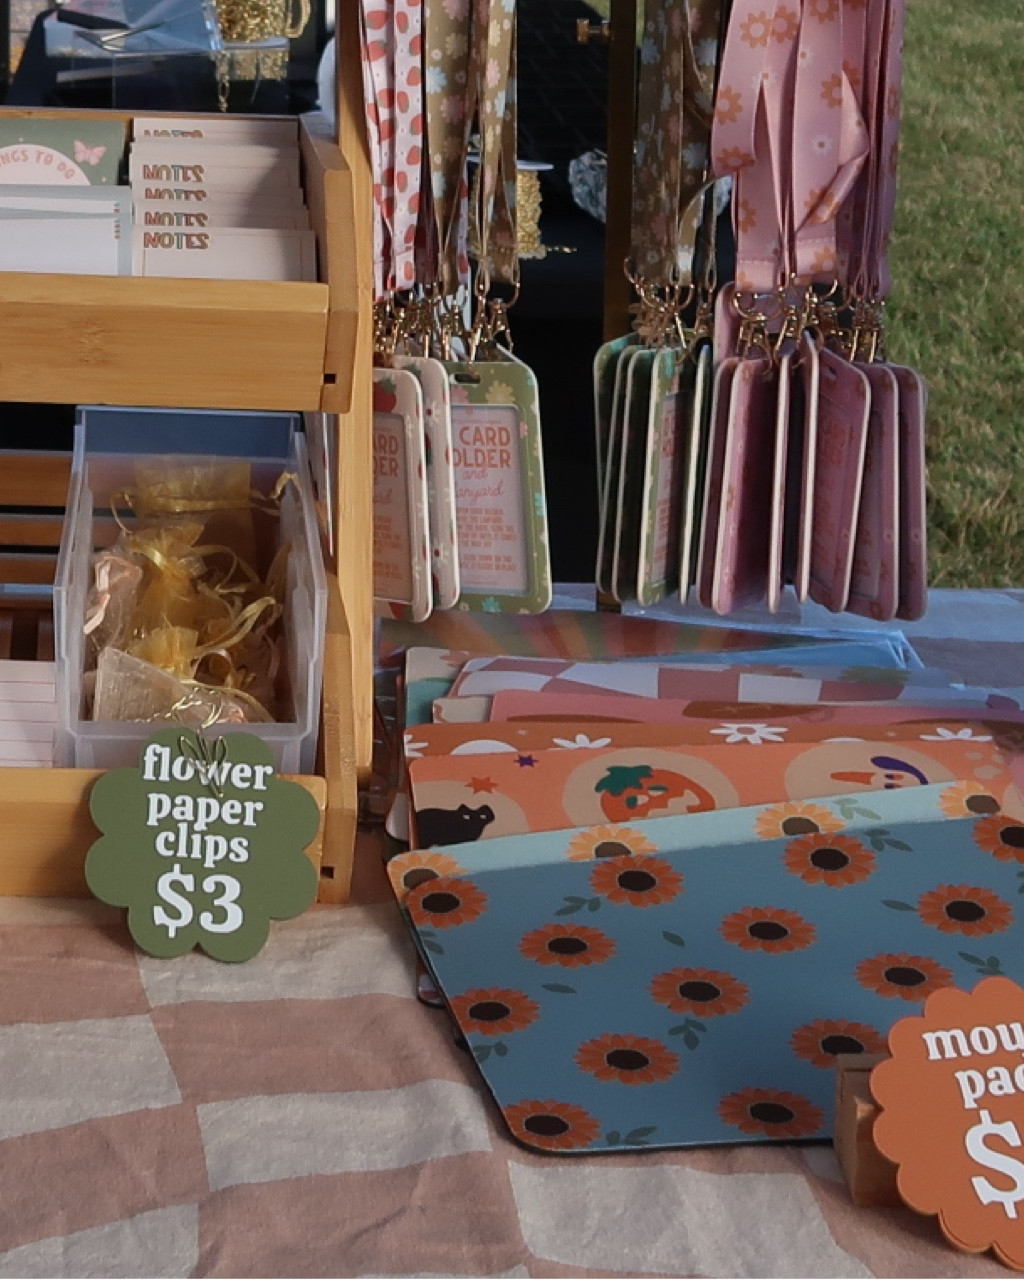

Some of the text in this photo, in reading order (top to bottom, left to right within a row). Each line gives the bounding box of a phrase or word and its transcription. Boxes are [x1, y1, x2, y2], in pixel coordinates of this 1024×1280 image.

[34, 149, 55, 166] TO
[56, 162, 77, 181] DO
[142, 164, 206, 183] NOTES
[143, 211, 209, 227] NOTES
[142, 231, 210, 250] NOTES
[459, 426, 511, 447] CARD
[453, 448, 512, 468] OLDER
[457, 480, 505, 504] anyard
[143, 743, 274, 791] flower
[146, 792, 265, 832] paper
[155, 822, 250, 868] clips
[153, 863, 244, 938] $3
[923, 1022, 1024, 1061] mou
